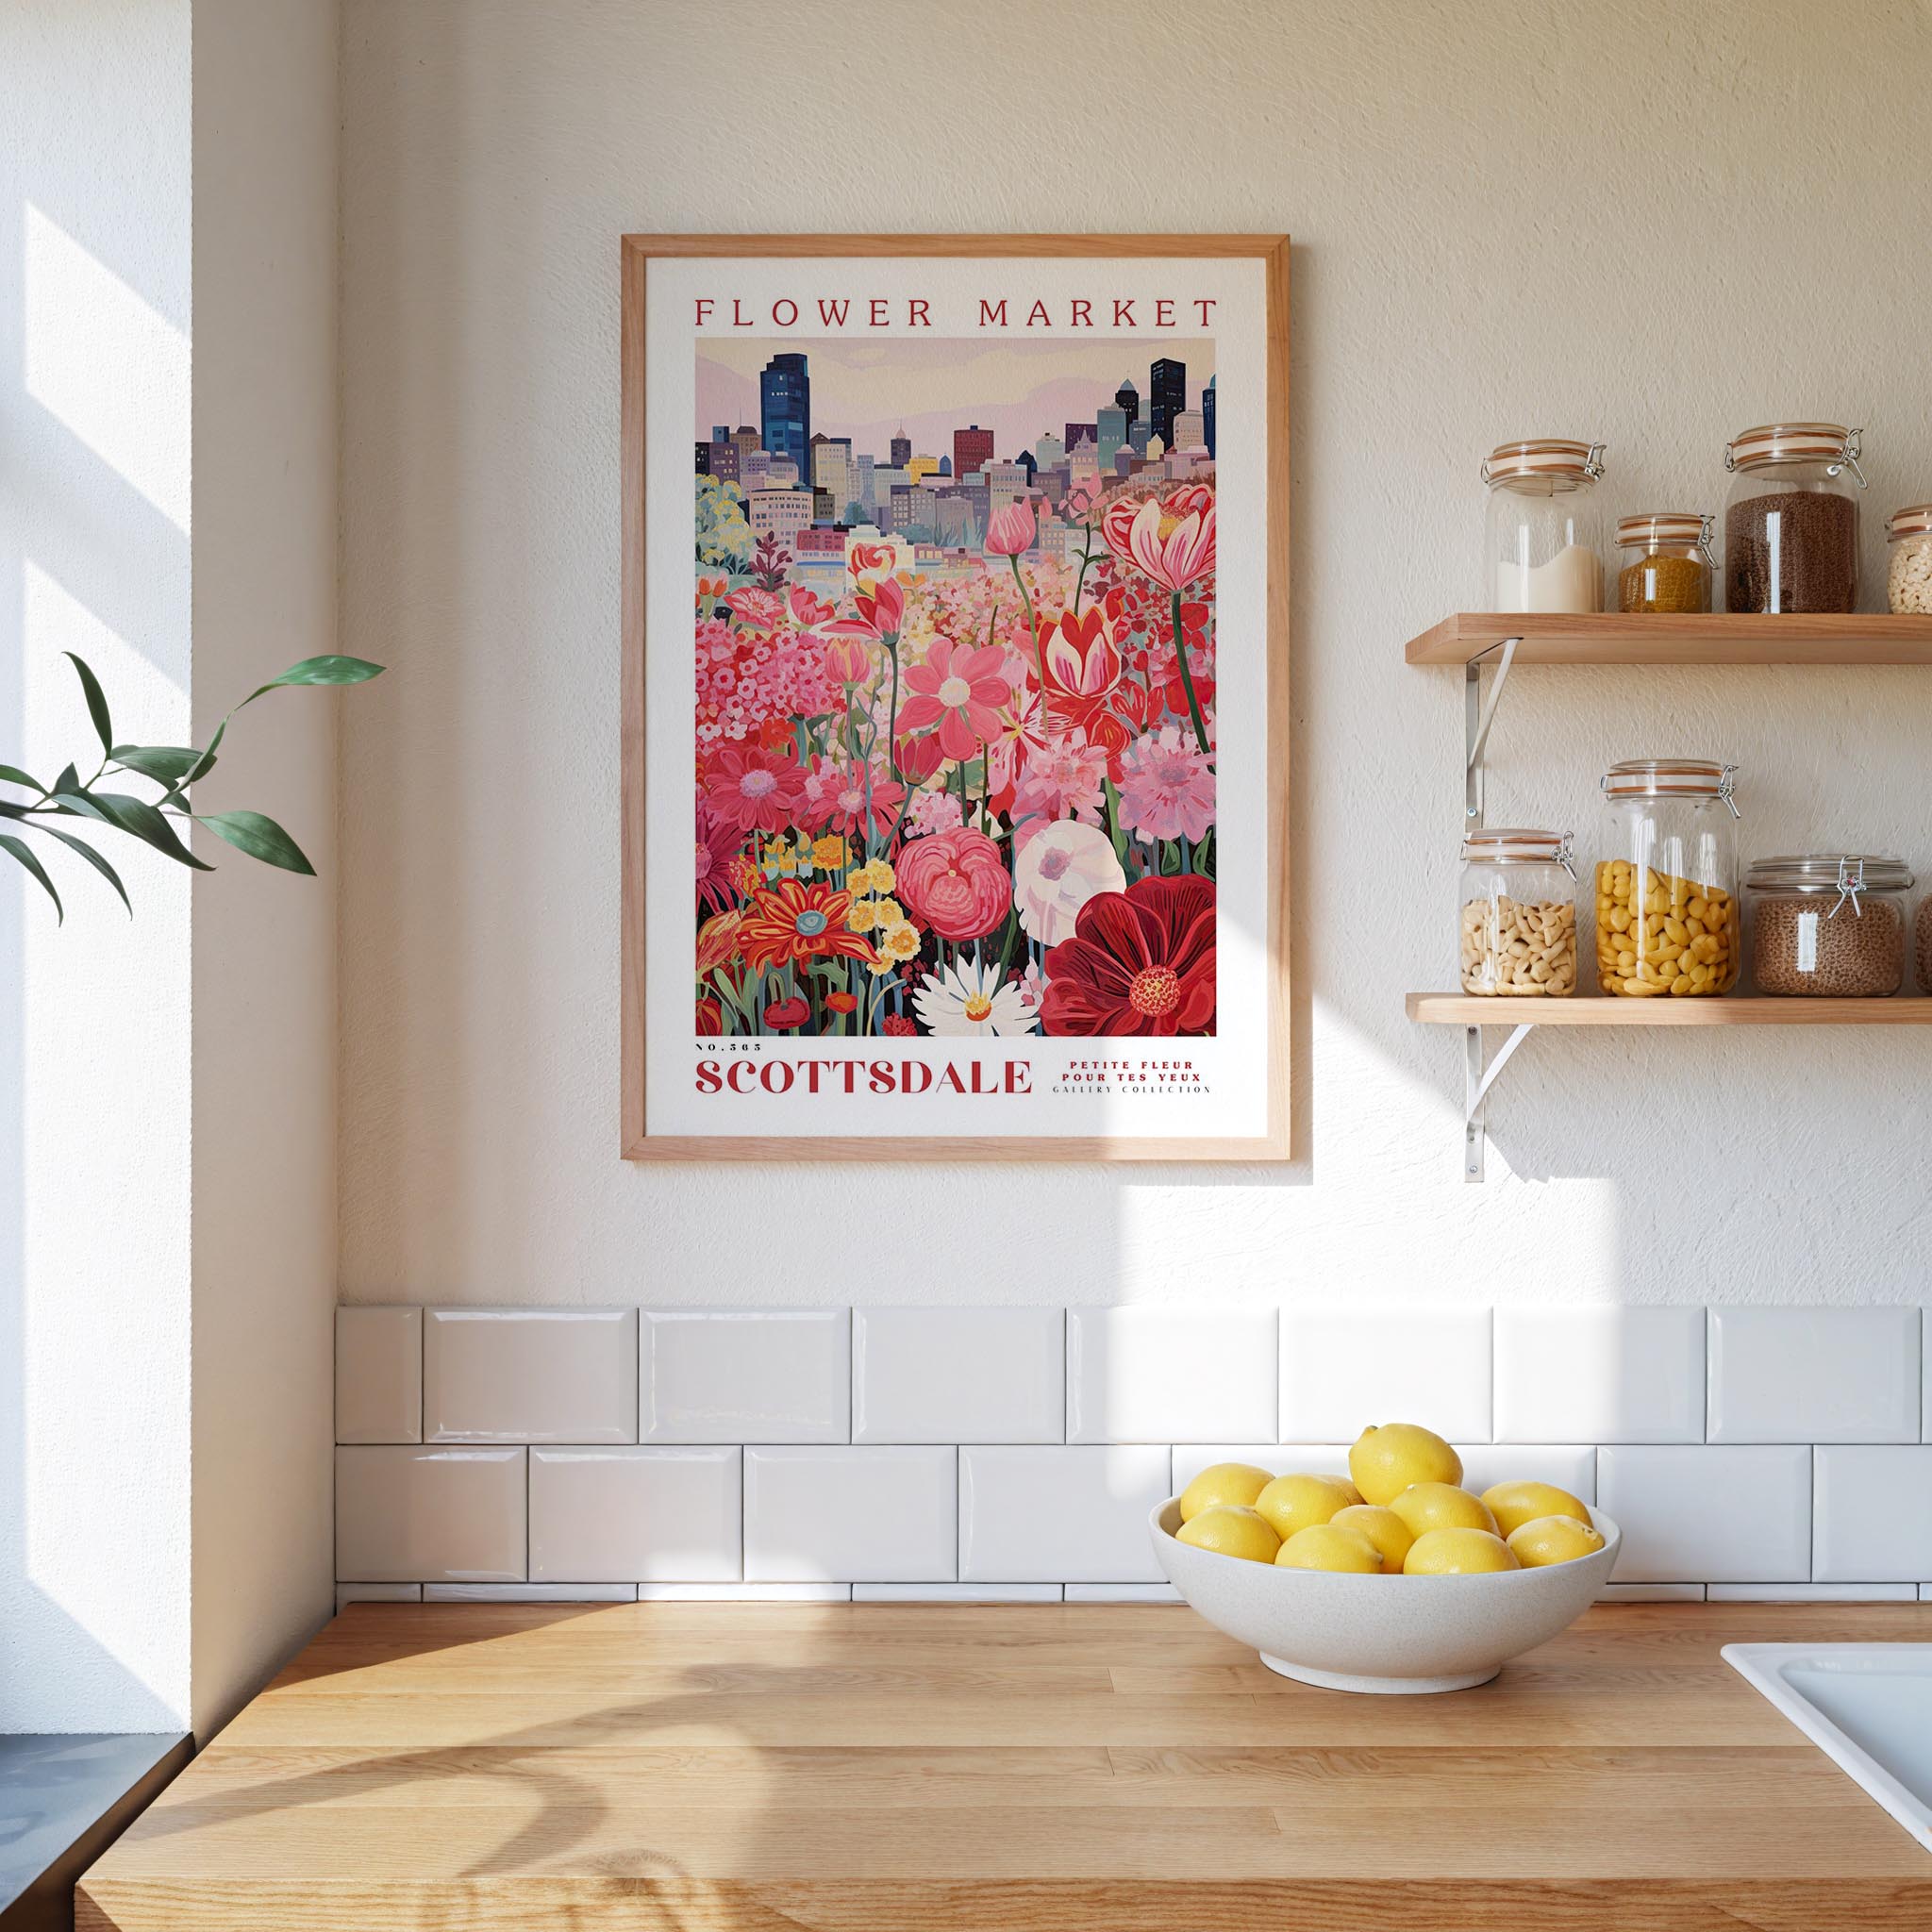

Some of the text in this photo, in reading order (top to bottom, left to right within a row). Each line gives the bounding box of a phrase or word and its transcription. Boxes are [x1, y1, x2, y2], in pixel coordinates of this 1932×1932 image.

[693, 298, 1218, 327] FLOWER MARKET
[1069, 1060, 1193, 1070] PETITE FLEUR
[694, 1059, 1033, 1094] SCOTTSDALE
[1061, 1073, 1201, 1083] POUR TES YEUX
[1052, 1086, 1211, 1094] GALLERY COLLECTION
